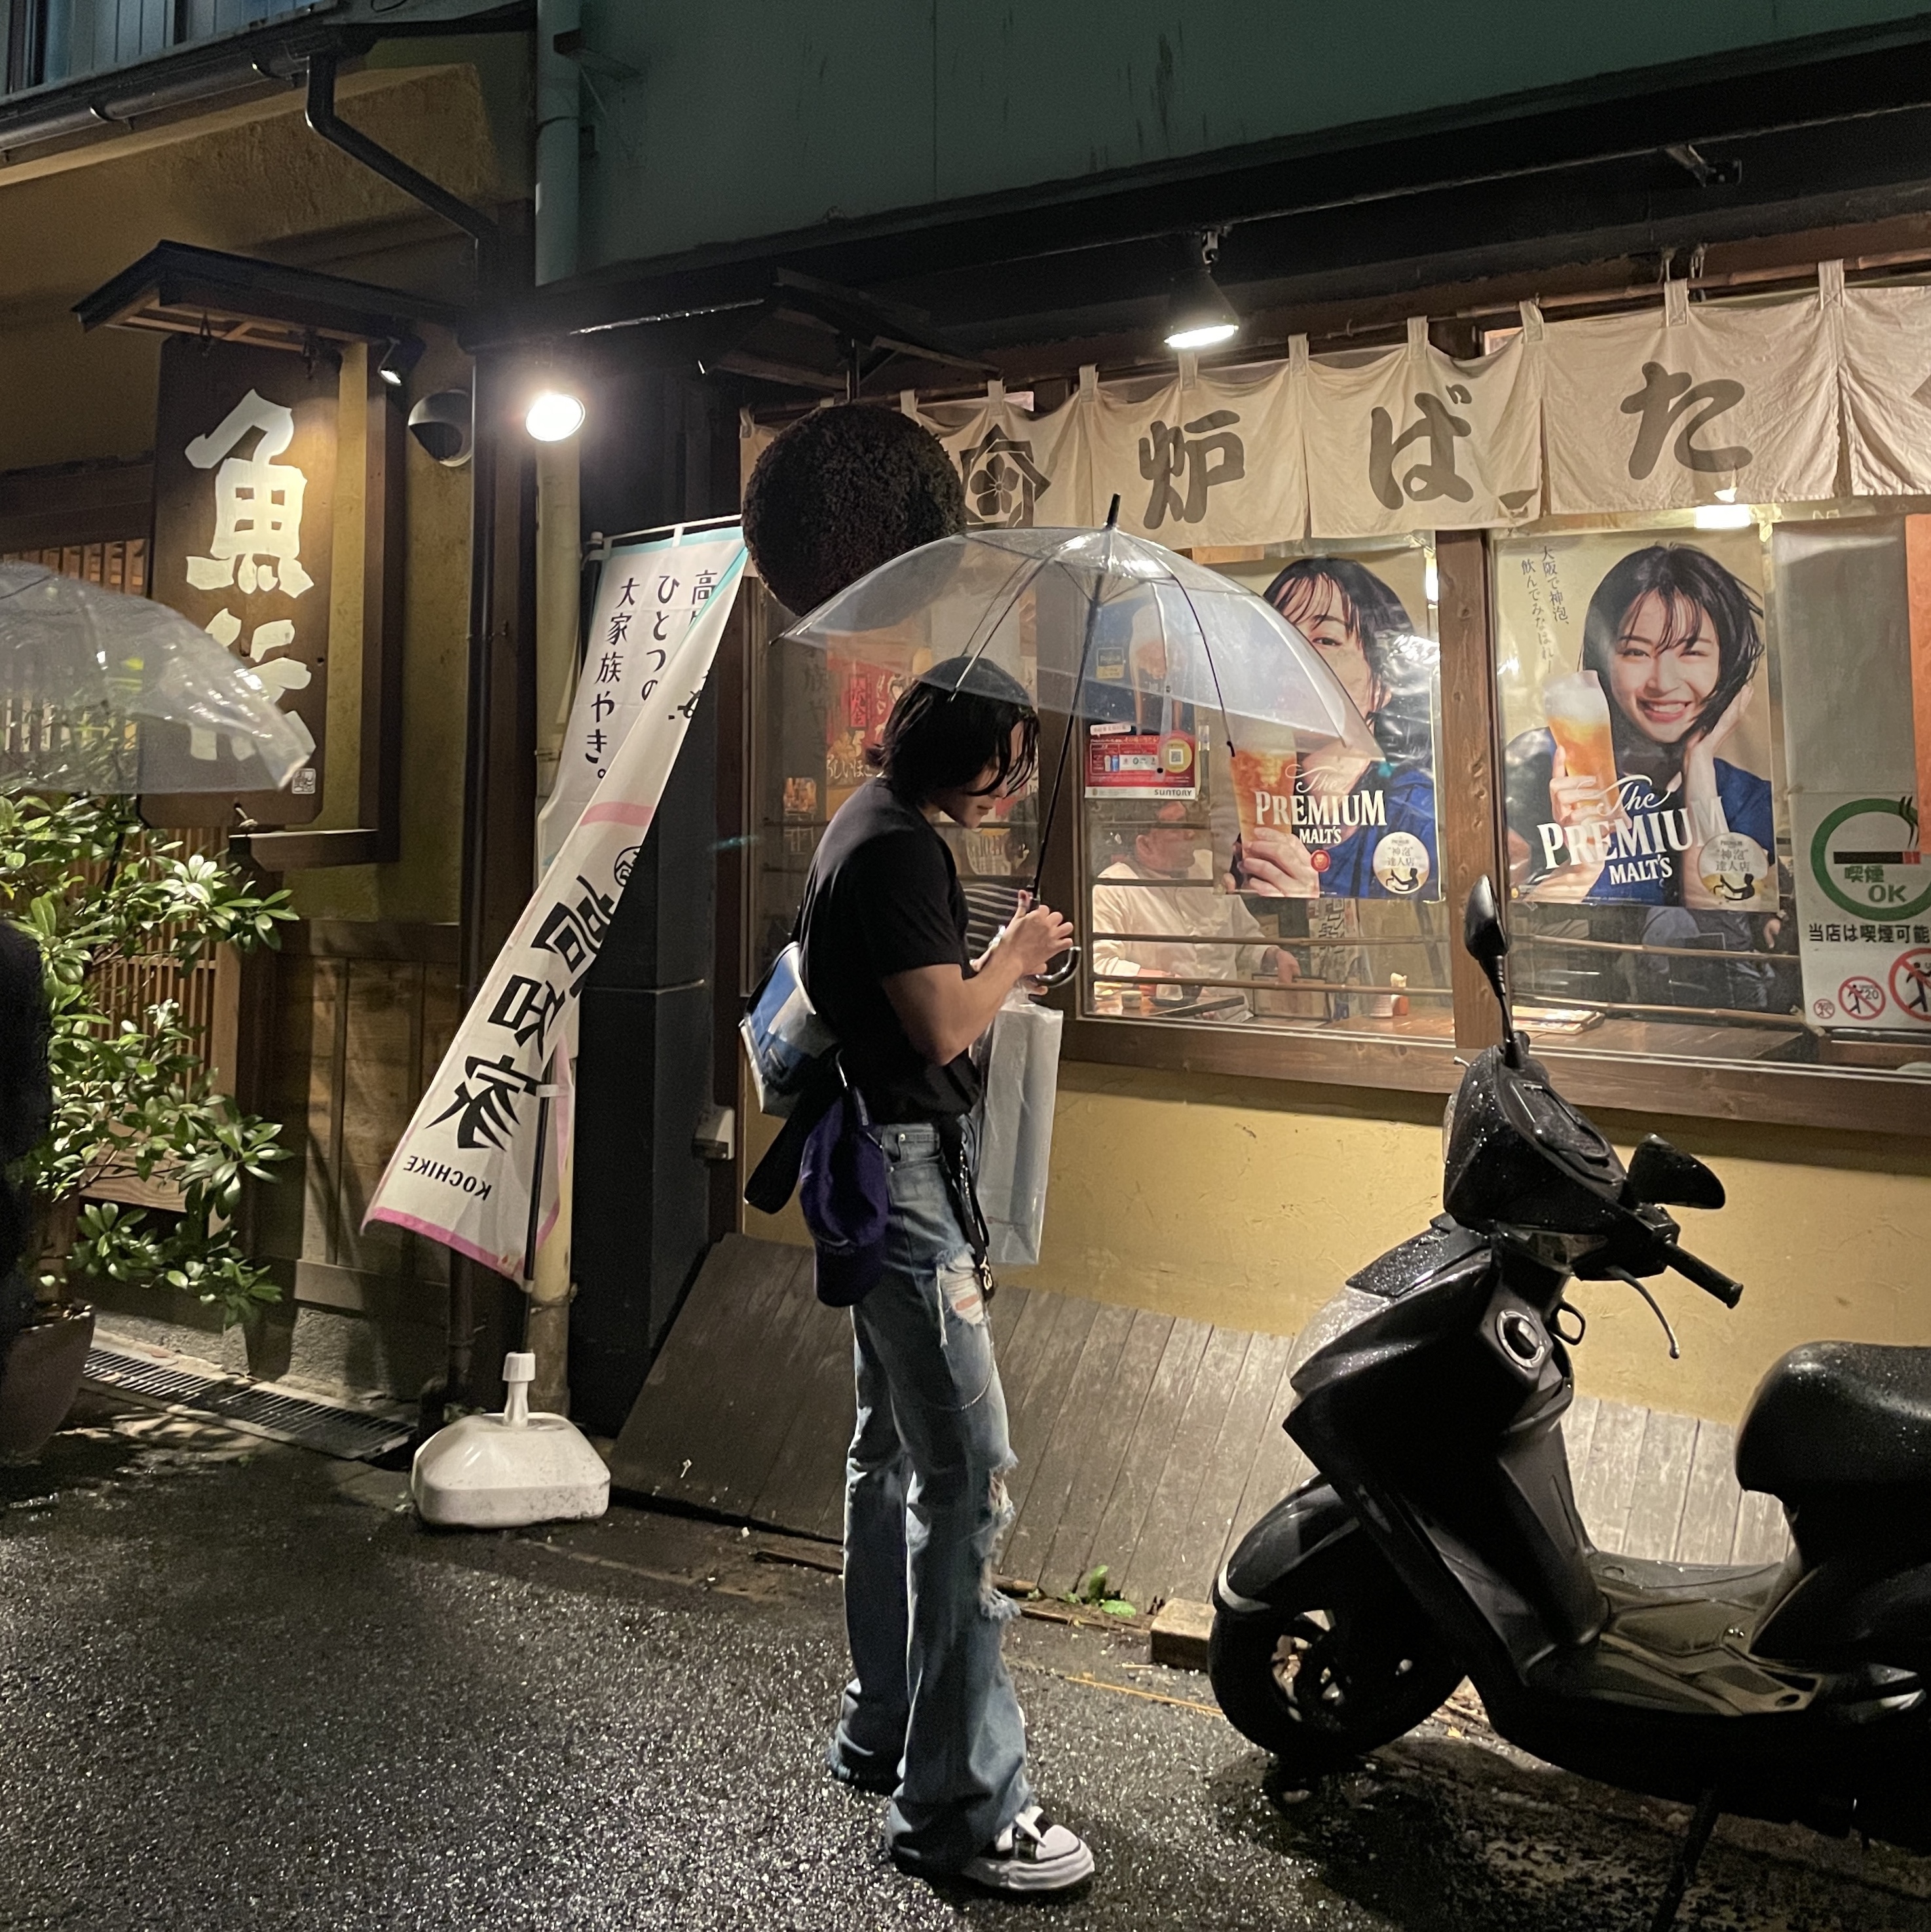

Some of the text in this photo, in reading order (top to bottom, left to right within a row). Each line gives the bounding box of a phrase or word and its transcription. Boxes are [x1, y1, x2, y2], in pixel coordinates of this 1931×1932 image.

[1255, 789, 1387, 826] PREMIUM
[1299, 827, 1342, 844] MALT'S
[1537, 795, 1731, 870] PREMIUM
[1609, 854, 1674, 886] MALT'S
[1844, 865, 1884, 883] 喫煙
[1868, 884, 1907, 903] OK
[1809, 923, 1930, 943] 当店は喫煙可能
